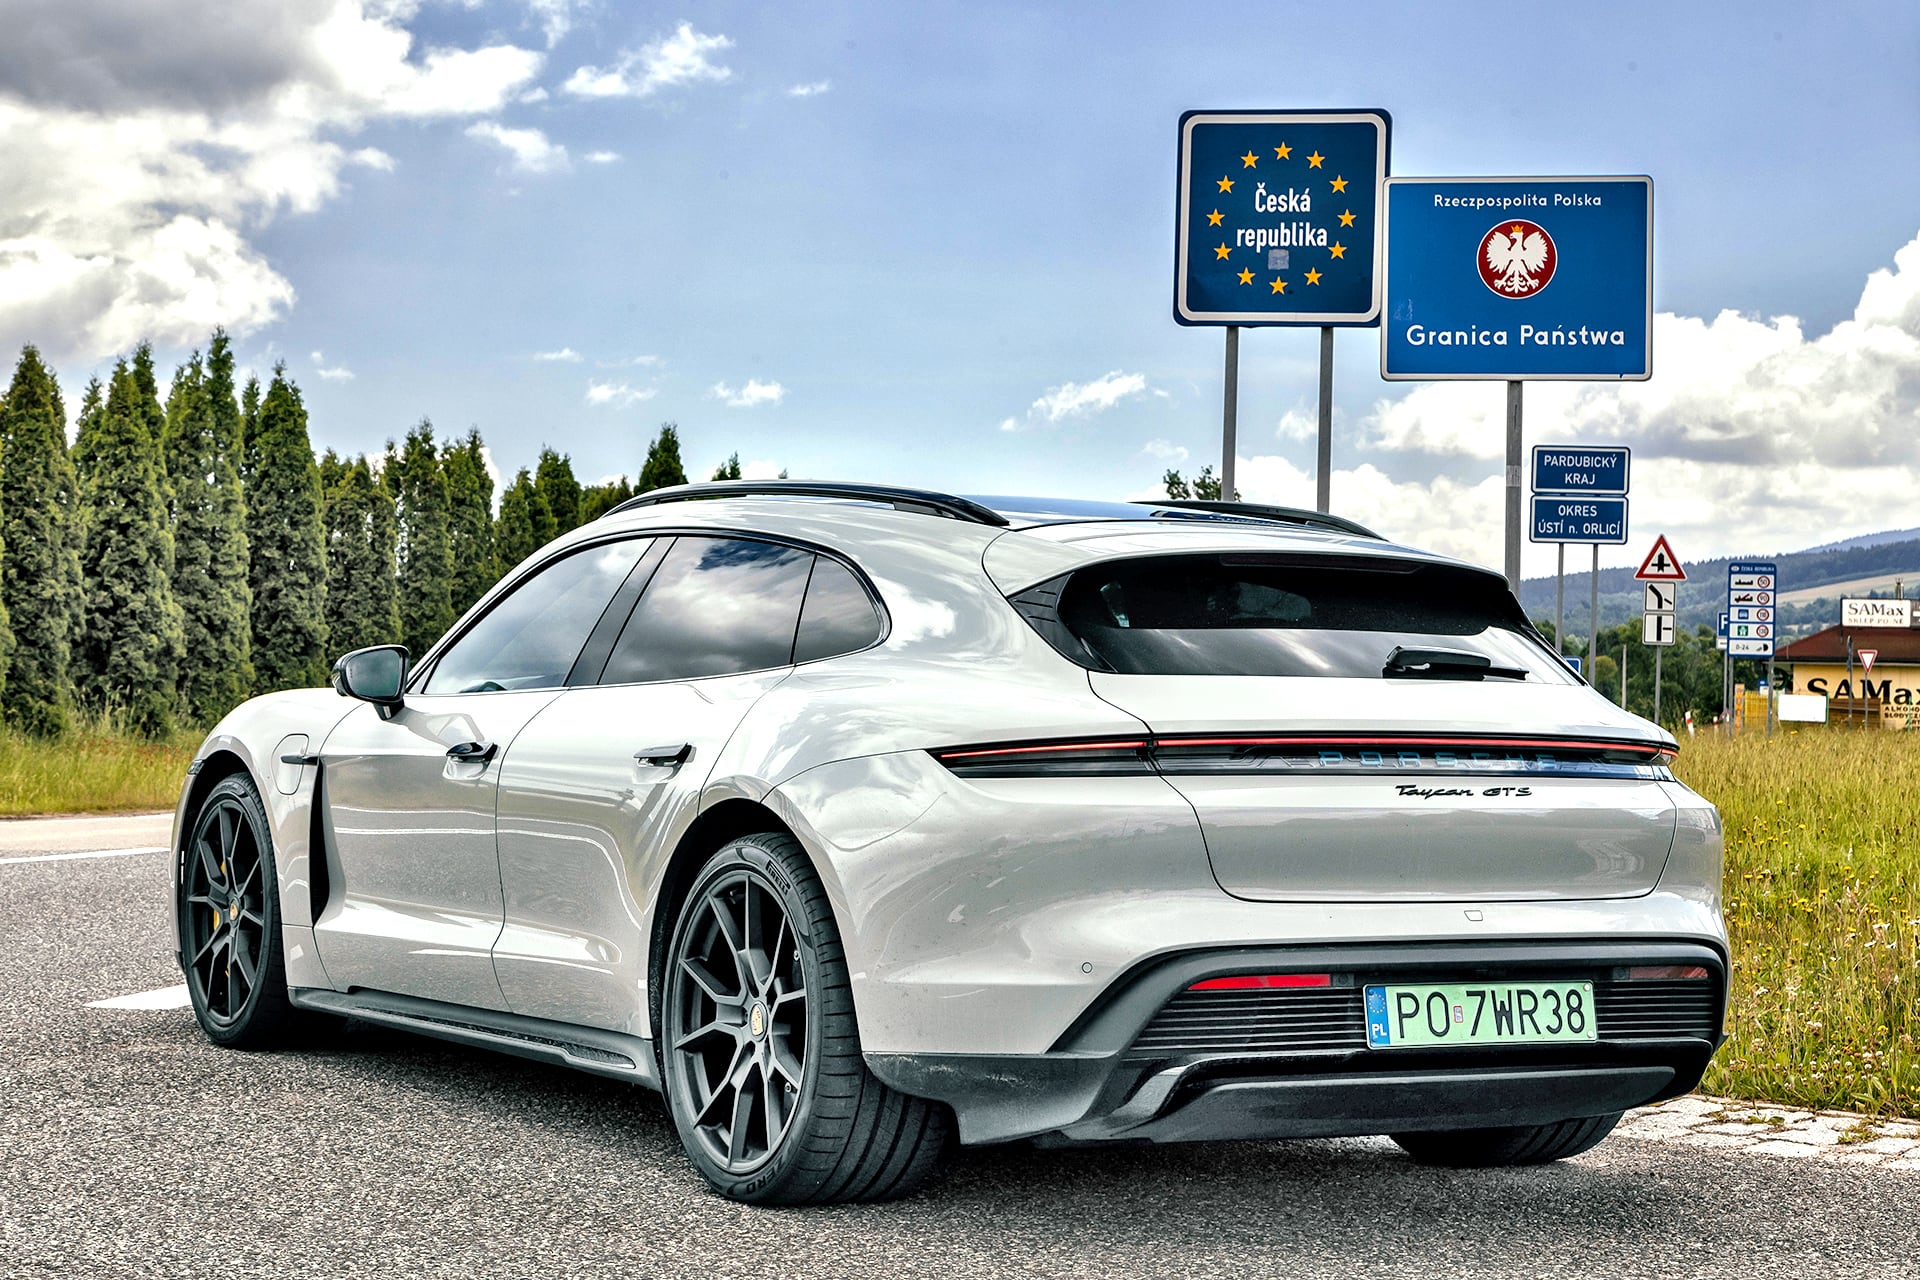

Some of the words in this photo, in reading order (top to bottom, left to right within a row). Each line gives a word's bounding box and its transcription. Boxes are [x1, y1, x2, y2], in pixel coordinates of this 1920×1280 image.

[1255, 182, 1311, 212] Česká
[1434, 194, 1547, 210] Rzeczpospolita
[1554, 194, 1602, 206] Polska
[1236, 222, 1328, 253] republika
[1406, 325, 1508, 346] Granica
[1520, 325, 1625, 346] Państwa
[1544, 454, 1617, 468] PARDUBICKÝ
[1564, 473, 1596, 485] KRAJ
[1558, 505, 1598, 517] OKRES
[1538, 519, 1564, 534] ÚSTÍ
[1568, 525, 1578, 534] n.
[1582, 521, 1621, 535] ORLICÍ
[1848, 602, 1904, 617] SAMax
[1807, 678, 1920, 706] SAMa
[1318, 751, 1557, 768] PORSCHE
[1395, 784, 1474, 800] Taycan
[1482, 787, 1533, 797] GTS
[1372, 1023, 1388, 1037] PL
